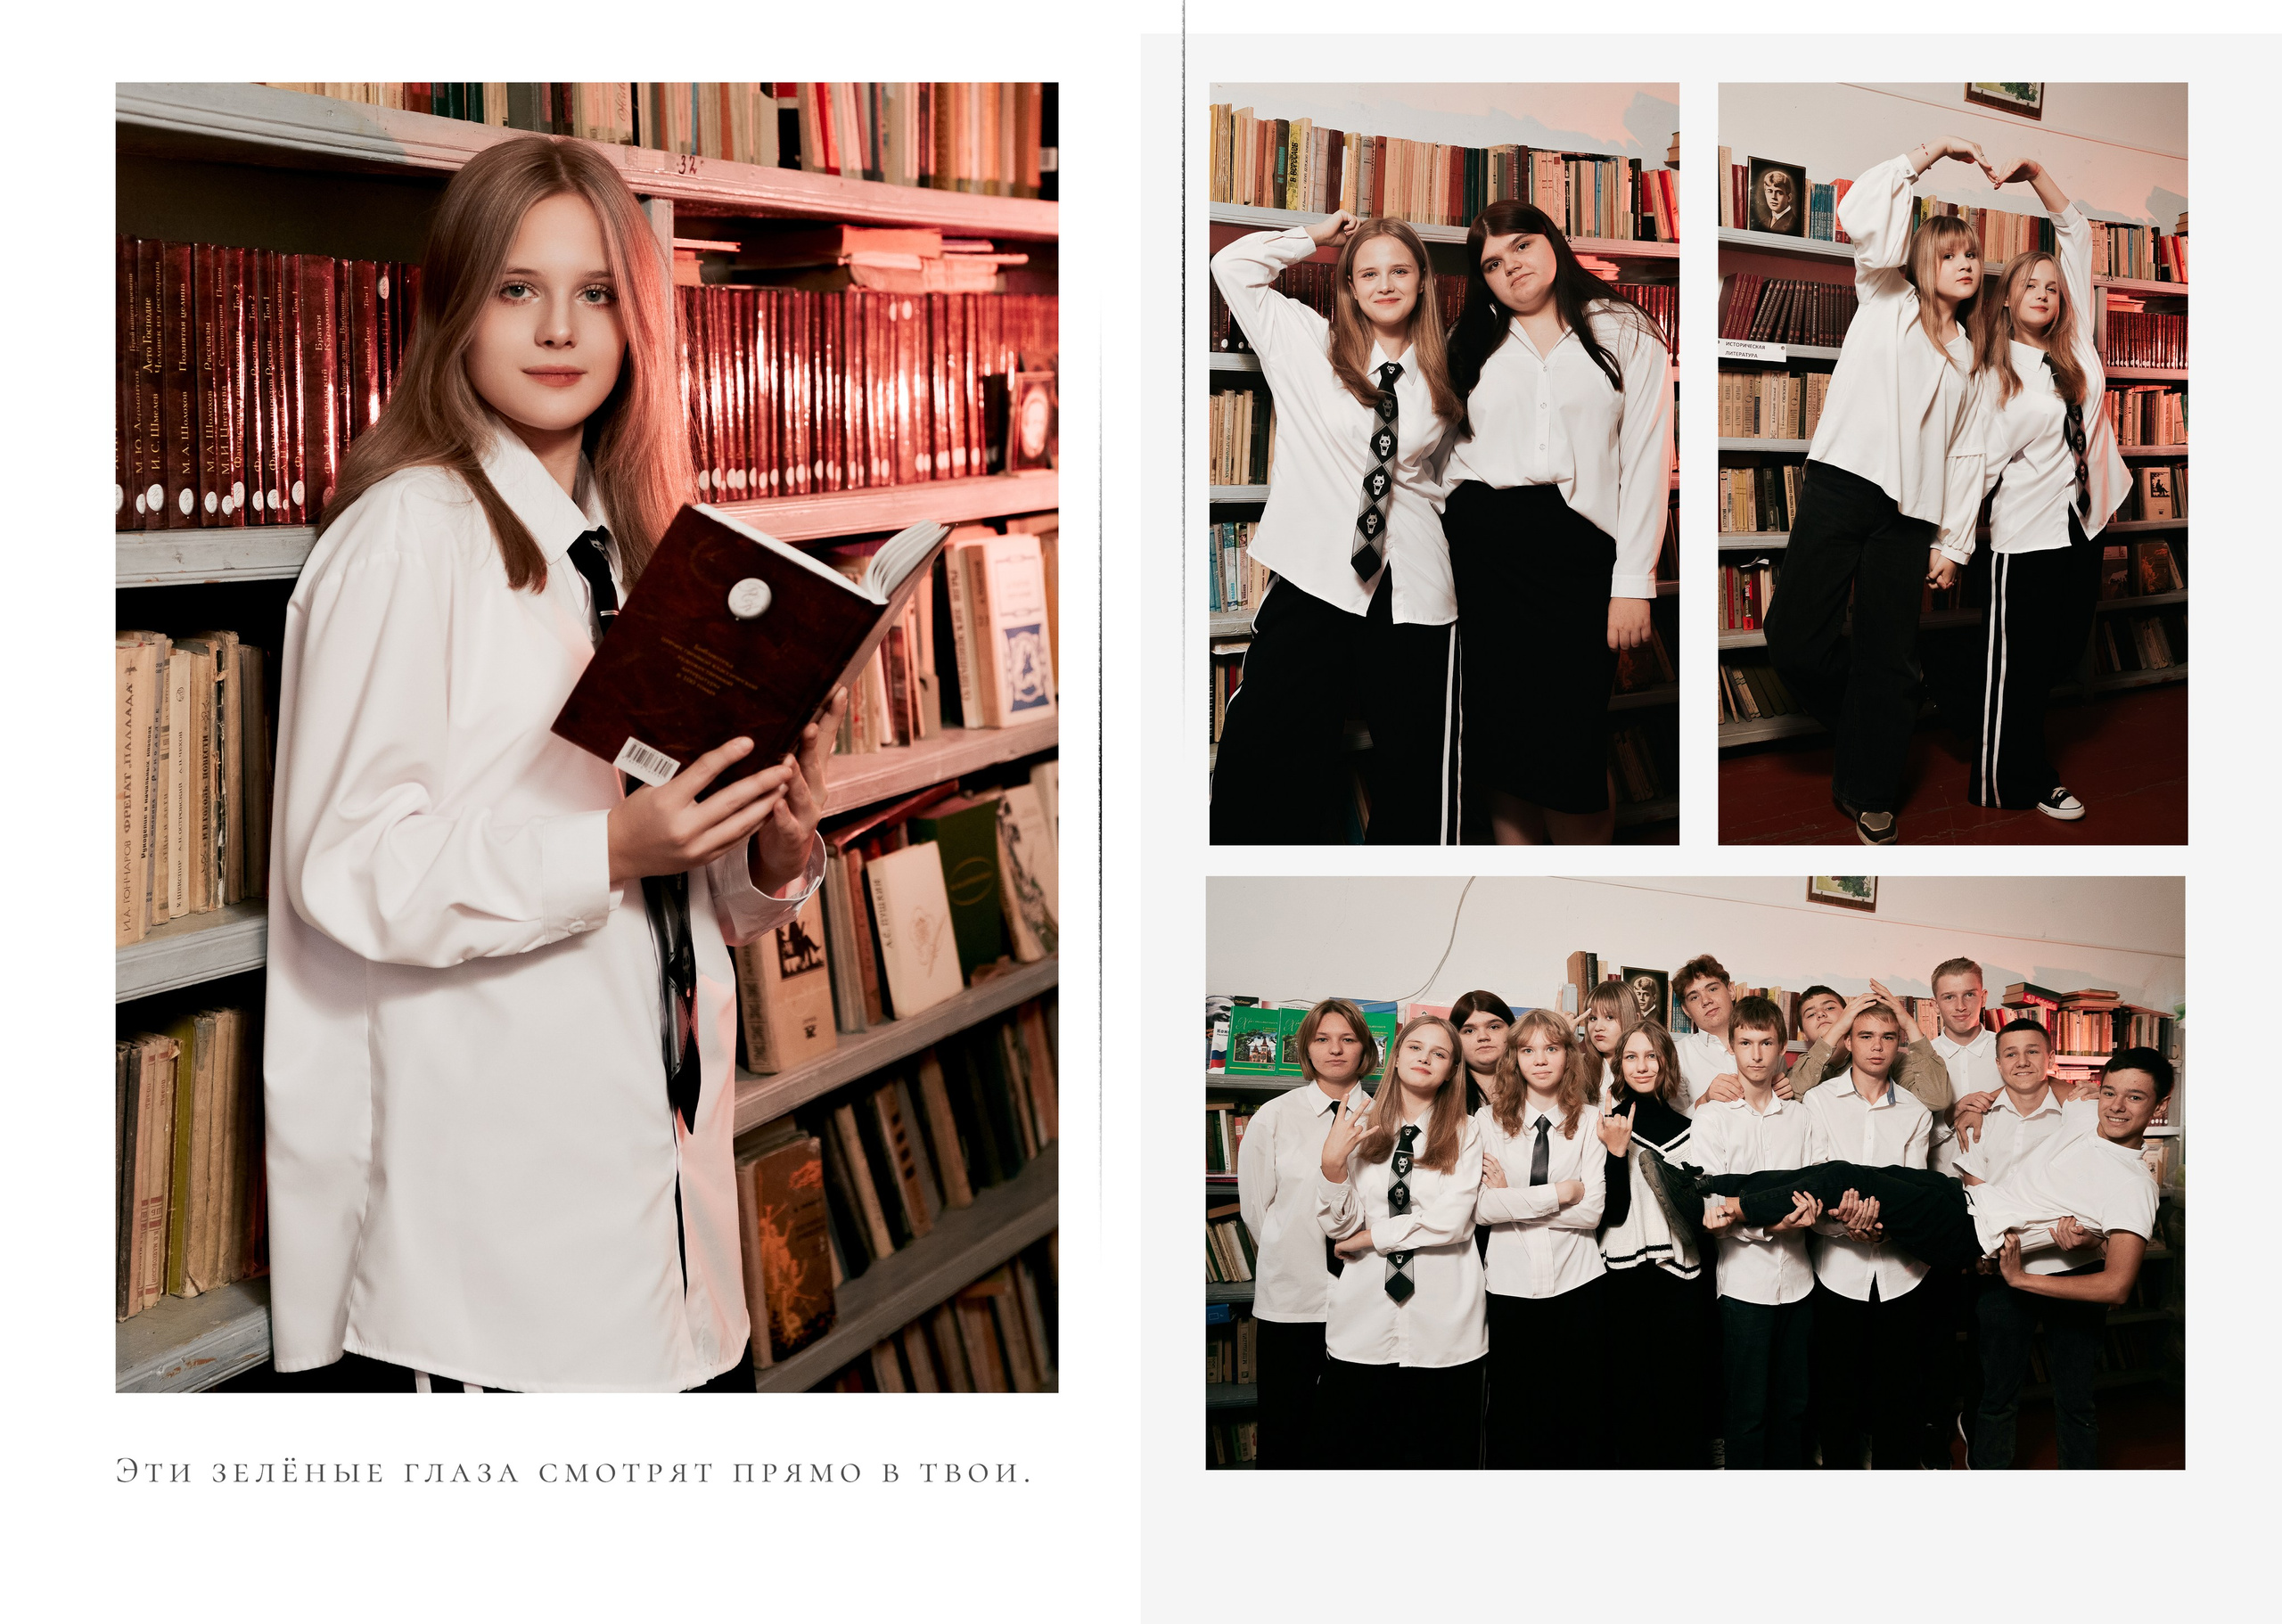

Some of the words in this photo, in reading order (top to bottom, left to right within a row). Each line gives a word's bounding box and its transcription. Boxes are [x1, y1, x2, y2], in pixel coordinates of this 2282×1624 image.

[678, 154, 697, 174] 32
[1290, 142, 1299, 176] ВЕРЕСАЕВ
[233, 293, 241, 310] Том
[291, 298, 300, 315] Том
[324, 288, 332, 350] Карамазовы
[143, 297, 152, 343] Господне
[156, 316, 161, 327] из
[315, 315, 324, 350] Братья
[143, 347, 152, 373] Лето
[154, 331, 162, 373] Человек
[179, 321, 187, 371] Поднятая
[203, 322, 212, 371] Рассказы
[265, 340, 273, 375] России
[1726, 341, 1766, 349] ИСТОРИЧЕСКАЯ
[134, 370, 142, 432] Лермонтов
[150, 393, 160, 437] Шмелев
[180, 391, 189, 439] Шолохов
[205, 390, 214, 439] Шолохов
[220, 385, 230, 438] Цветаева
[321, 368, 330, 437] Достоевский
[135, 436, 142, 454] Ю.
[151, 440, 160, 453] С.
[182, 443, 190, 455] А.
[206, 442, 214, 455] А.
[220, 441, 229, 455] И.
[234, 408, 242, 468] Фантастика
[135, 458, 143, 473] М.
[151, 456, 160, 470] И.
[182, 459, 191, 474] М.
[207, 458, 215, 472] М.
[221, 459, 230, 474] М.
[201, 734, 209, 780] ПОВЕСТИ
[143, 760, 151, 804] начальных
[123, 773, 132, 834] ФРЕГАТ
[123, 840, 131, 904] ГОНЧАРОВ
[873, 878, 890, 926] ПУШКИН
